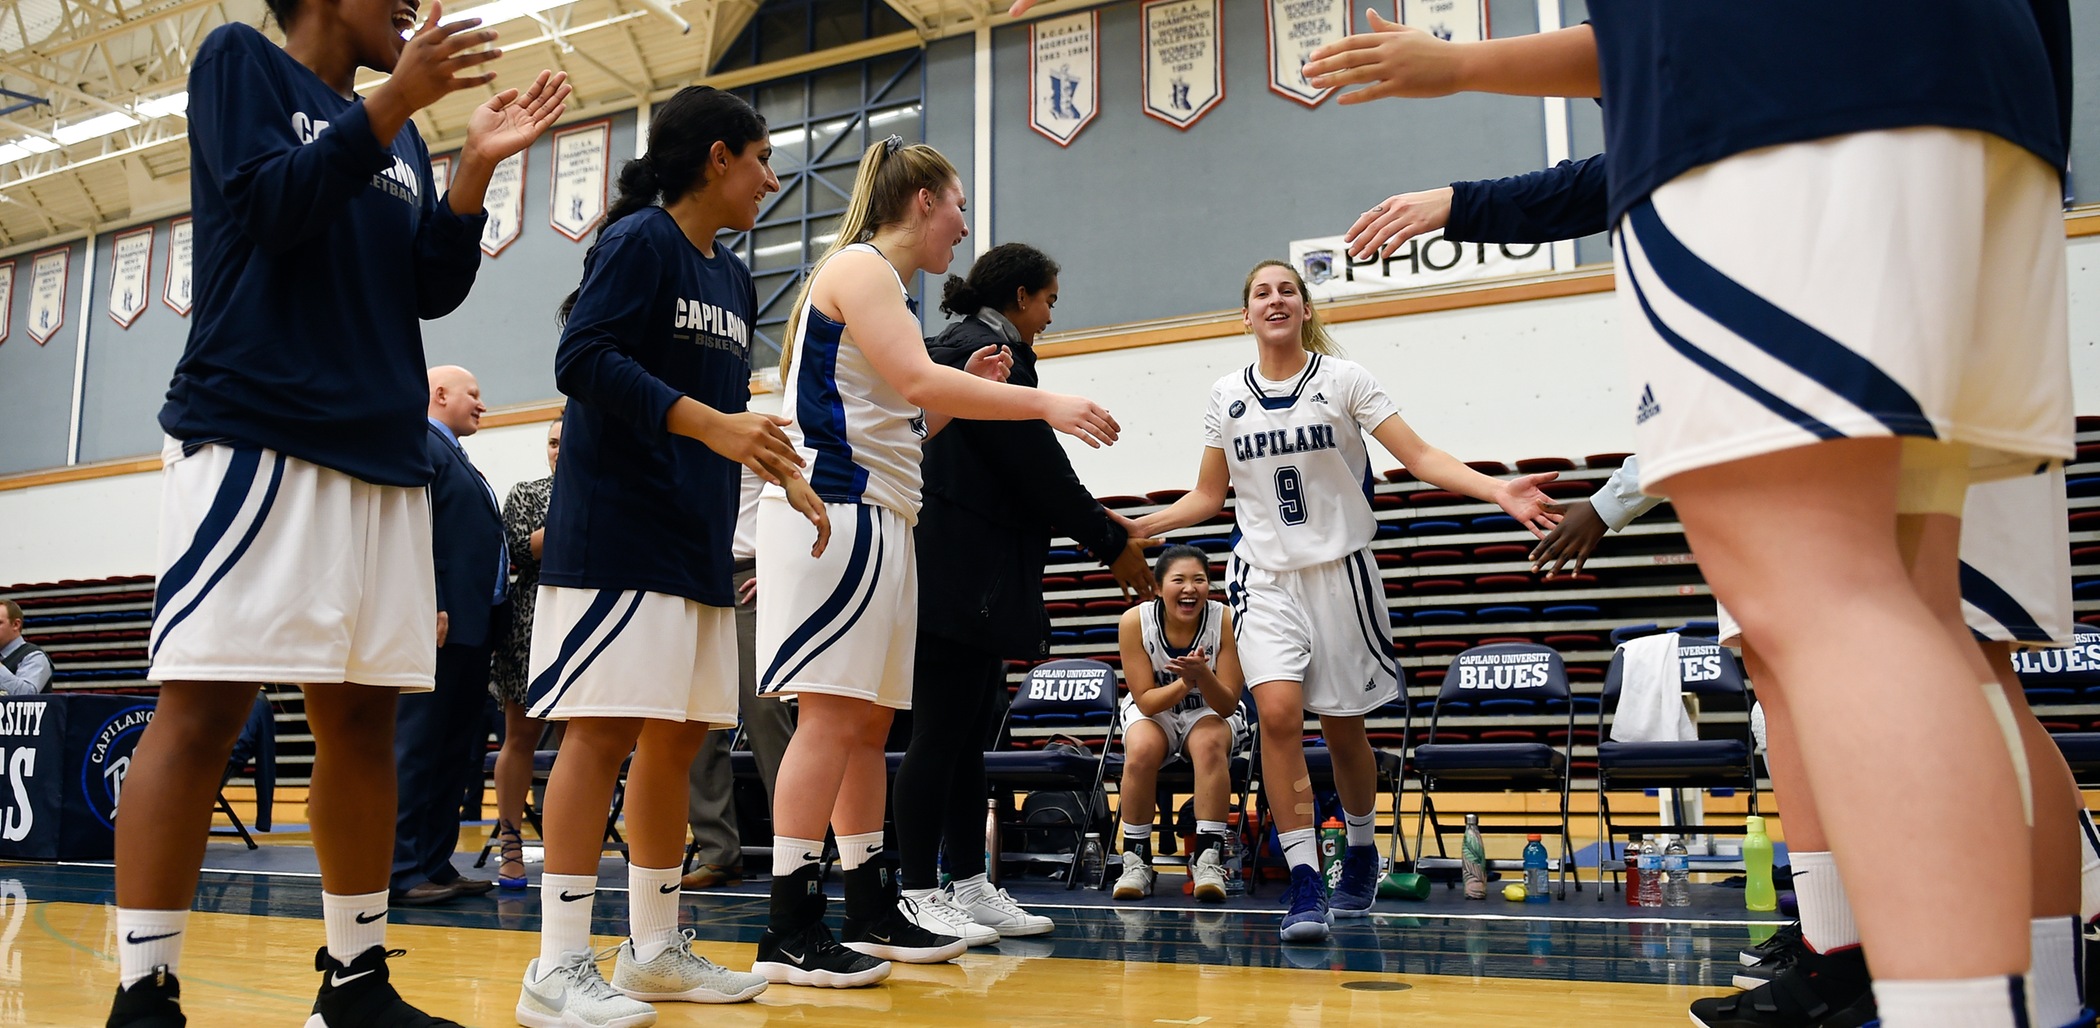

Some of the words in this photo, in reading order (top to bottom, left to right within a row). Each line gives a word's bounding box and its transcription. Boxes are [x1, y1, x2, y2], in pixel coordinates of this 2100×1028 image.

[1152, 11, 1210, 29] CHAMPIONS
[1158, 21, 1205, 37] WOMEN'S
[1288, 24, 1331, 40] SOCCER
[1040, 33, 1089, 50] AGGREGATE
[1152, 30, 1210, 47] VOLLEYBALL
[1158, 41, 1206, 56] WOMEN'S
[1161, 50, 1203, 65] SOCCER
[675, 297, 749, 350] CAPILANO
[1274, 465, 1308, 526] 9
[1460, 654, 1500, 665] CAPILANO
[1501, 653, 1551, 664] UNIVERSITY
[1033, 669, 1066, 678] CAPILANO
[1066, 669, 1107, 678] UNIVERSITY
[1459, 663, 1549, 690] BLUES
[1028, 679, 1103, 701] BLUES
[91, 711, 155, 763] CAPILANO
